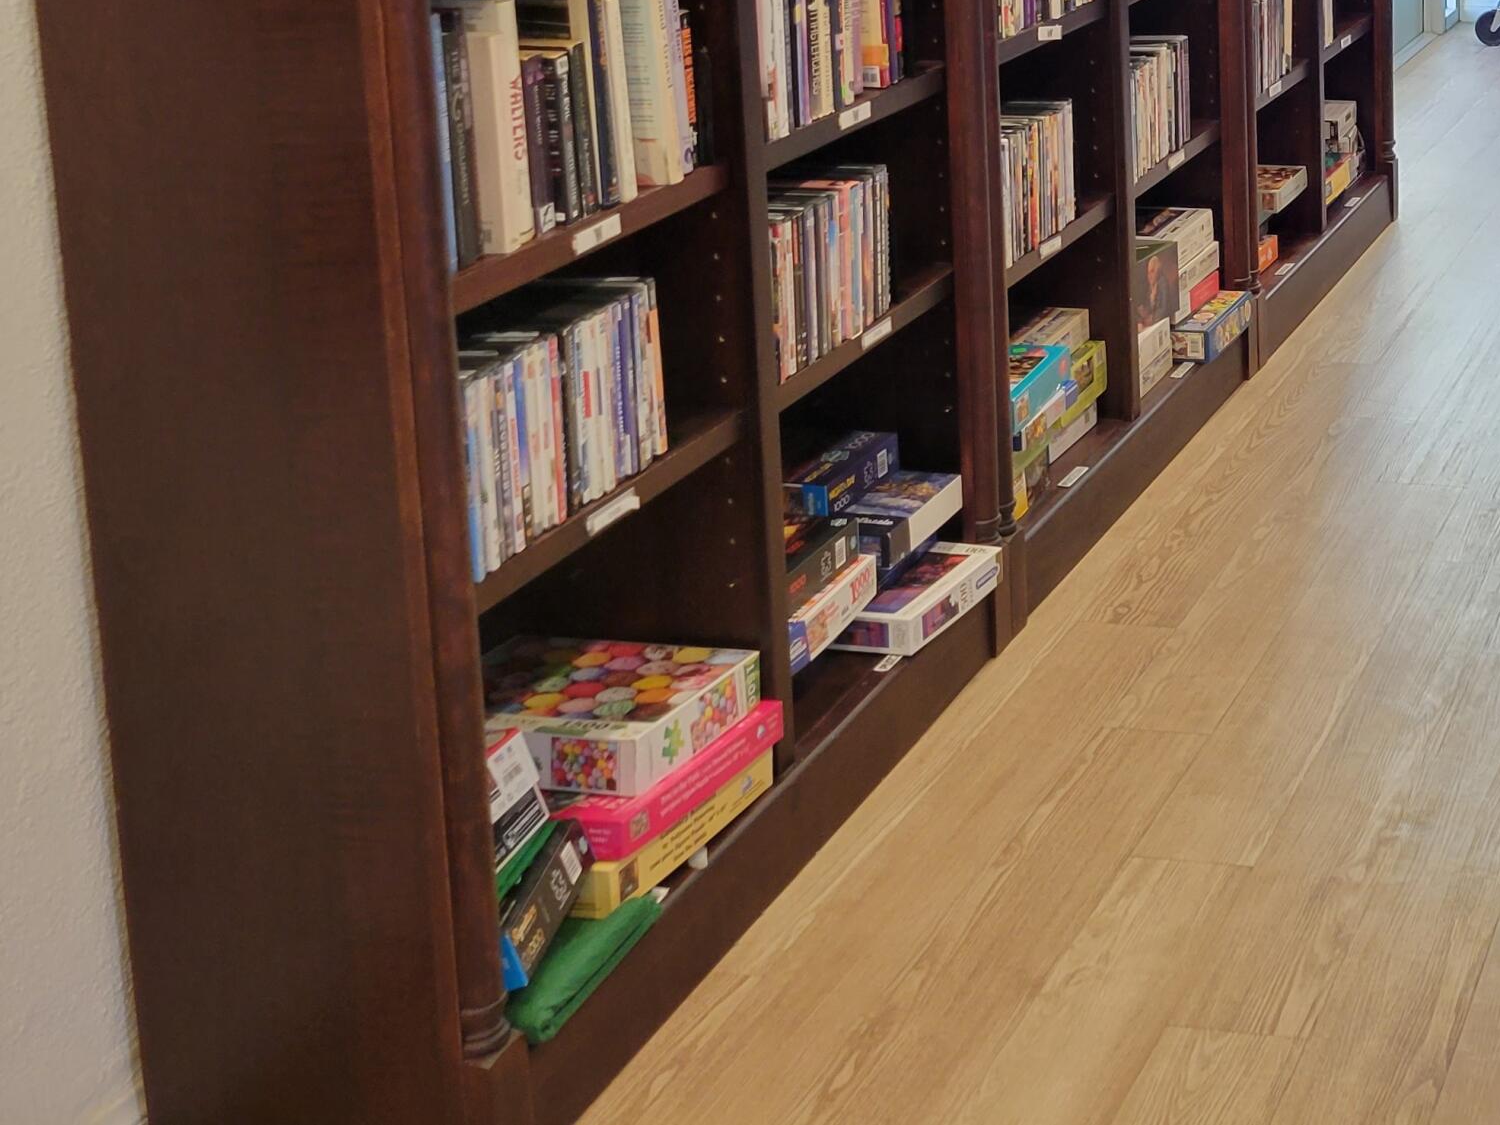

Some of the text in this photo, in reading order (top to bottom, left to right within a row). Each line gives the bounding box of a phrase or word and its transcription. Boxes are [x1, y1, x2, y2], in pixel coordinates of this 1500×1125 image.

[559, 74, 570, 95] FOX
[509, 75, 528, 161] WALTERS
[561, 97, 572, 122] EVIL
